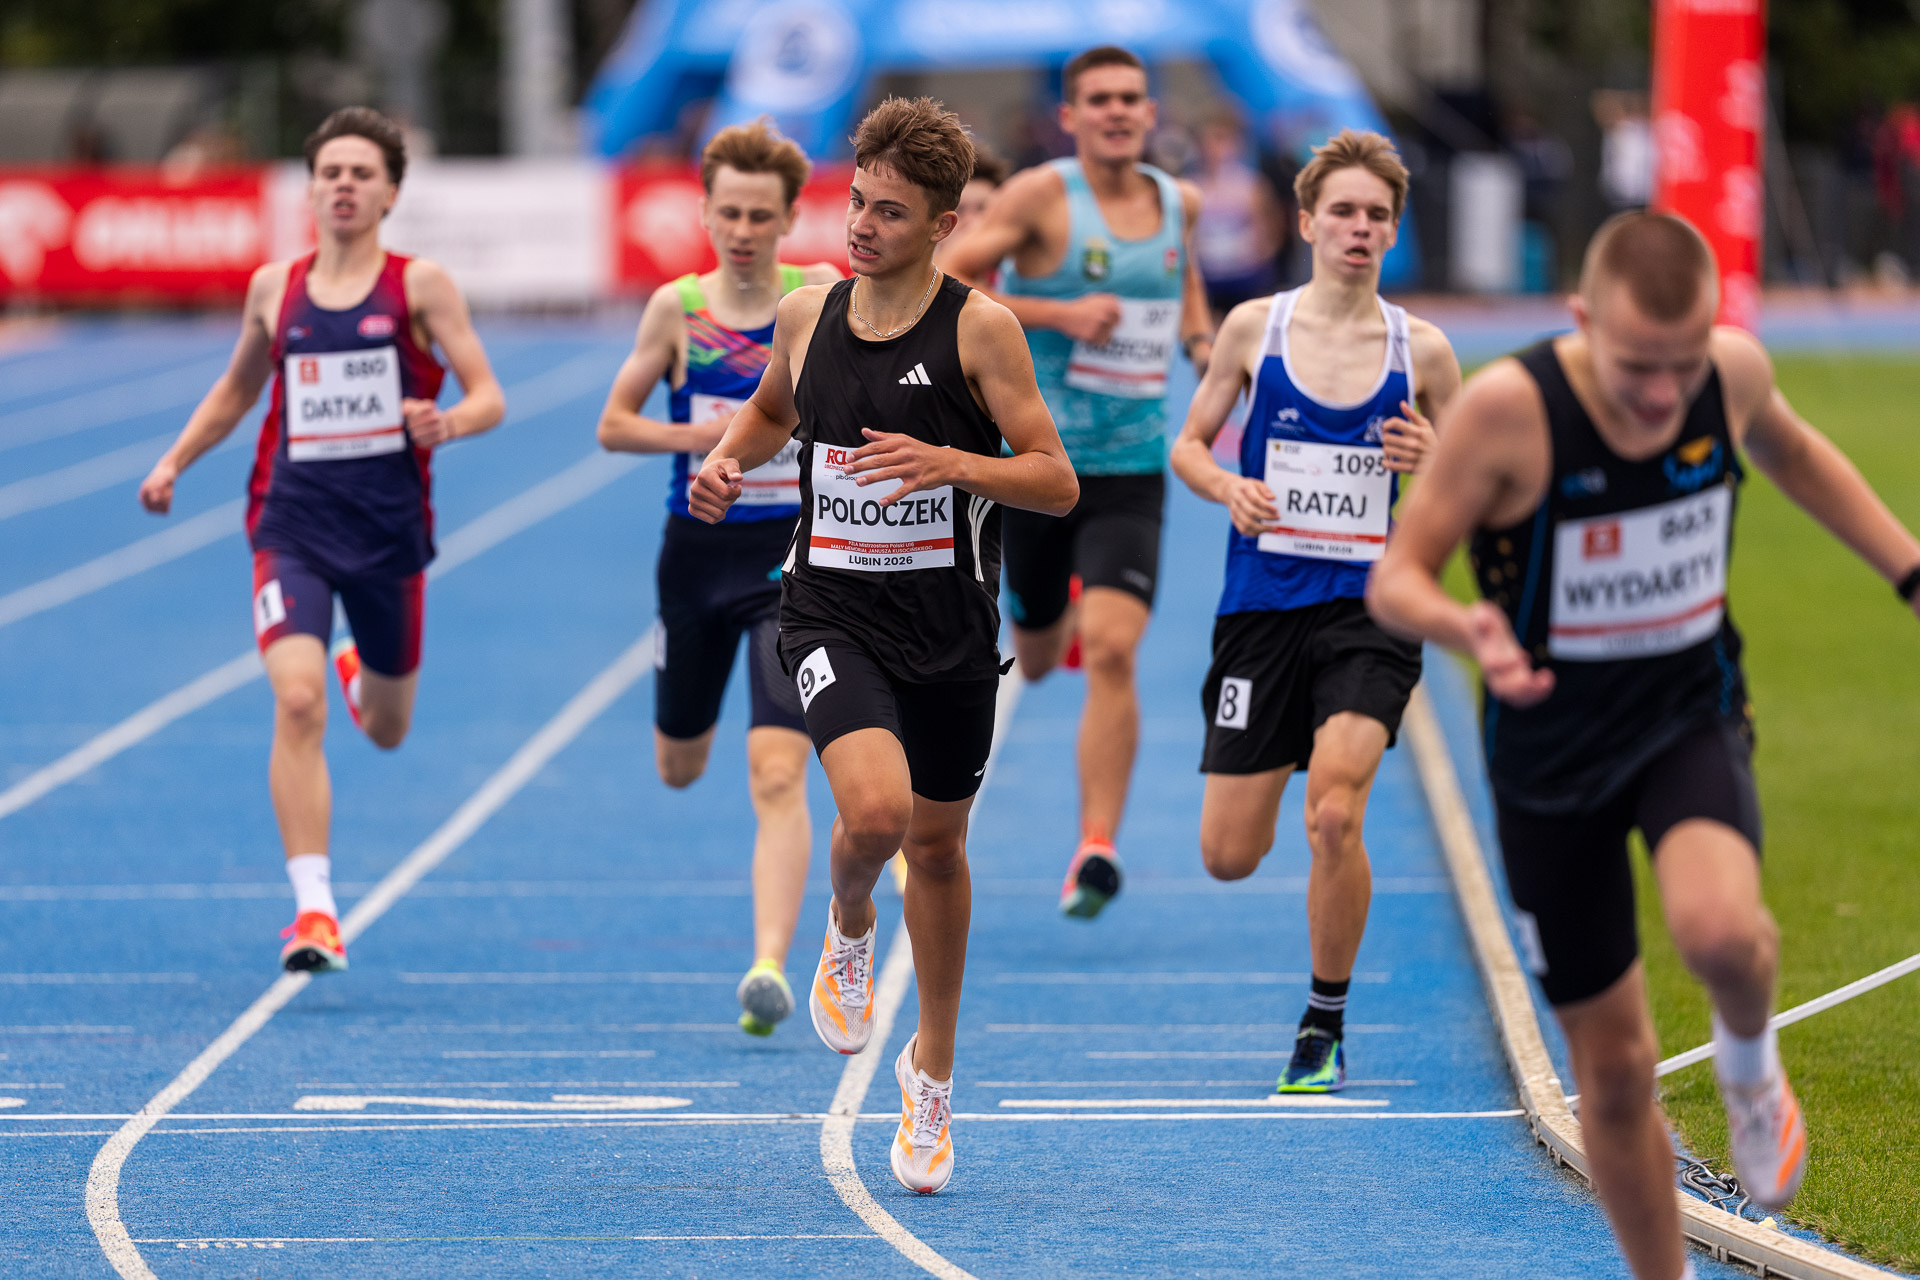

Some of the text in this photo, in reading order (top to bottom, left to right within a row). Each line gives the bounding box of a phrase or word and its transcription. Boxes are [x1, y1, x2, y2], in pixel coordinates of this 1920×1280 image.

[343, 356, 388, 380] 880
[301, 393, 384, 422] DATKA
[1333, 453, 1387, 478] 1095
[818, 494, 948, 526] POLOCZEK
[1286, 488, 1367, 519] RATAJ
[848, 554, 913, 566] LUBIN 2026
[1562, 550, 1717, 610] WYDARTY
[1221, 684, 1238, 721] 8
